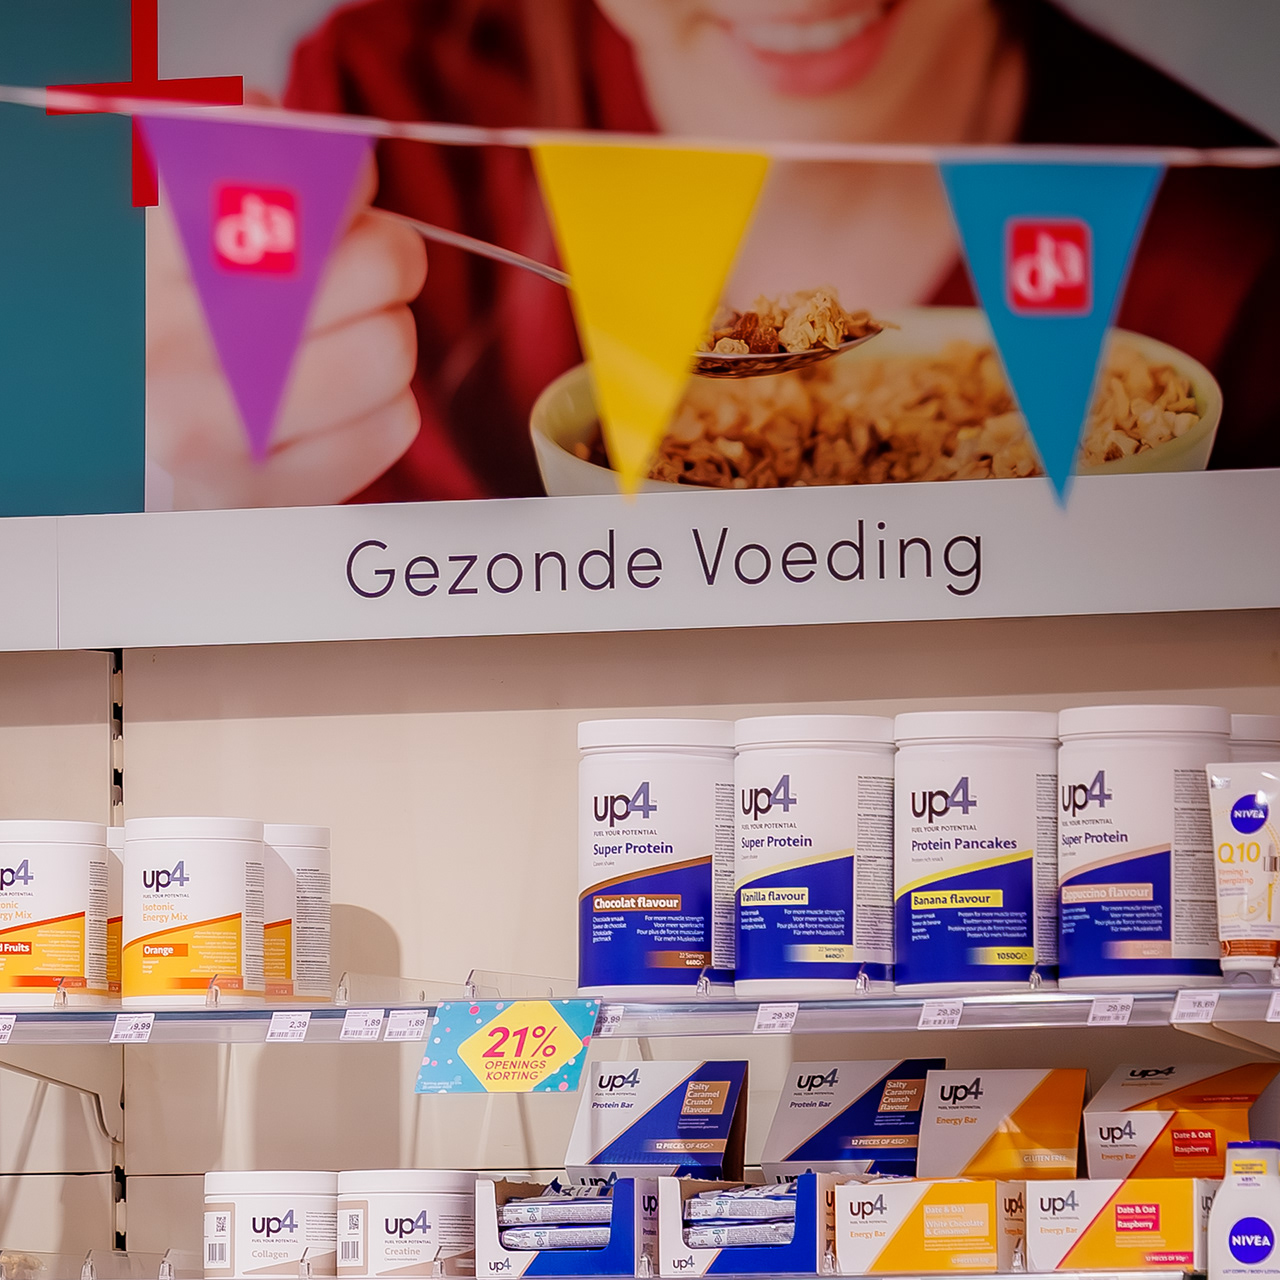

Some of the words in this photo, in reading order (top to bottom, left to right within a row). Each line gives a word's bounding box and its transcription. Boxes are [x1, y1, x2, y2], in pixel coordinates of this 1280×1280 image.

[346, 529, 663, 599] Gezonde
[691, 520, 982, 597] Voeding
[741, 775, 796, 821] up4
[911, 776, 977, 824] up4
[1062, 770, 1112, 817] up4
[594, 782, 657, 827] up4
[1233, 809, 1265, 820] NIVEA
[593, 843, 622, 856] Super
[625, 842, 673, 854] Protein
[741, 836, 765, 849] Super
[767, 835, 812, 848] Protein
[911, 838, 951, 851] Protein
[954, 837, 1017, 850] Pancakes
[1218, 842, 1260, 863] Q10
[143, 860, 189, 892] up4
[742, 892, 766, 902] Vanilla
[768, 890, 806, 902] flavour
[913, 894, 947, 906] Banana
[950, 893, 991, 904] flavour
[594, 897, 635, 910] Chocolat
[637, 897, 679, 909] flavour
[15, 911, 32, 919] Mix
[5, 943, 30, 953] Fruits
[144, 945, 174, 957] Orange
[483, 1026, 558, 1057] 21%
[485, 1060, 547, 1072] OPENINGS
[599, 1068, 640, 1091] up4
[941, 1078, 983, 1104] up4
[591, 1102, 618, 1110] Protein
[251, 1210, 298, 1240] up4
[385, 1210, 431, 1240] up4
[1231, 1235, 1271, 1247] NIVEA
[251, 1249, 289, 1260] Collagen
[384, 1246, 420, 1256] Creatine
